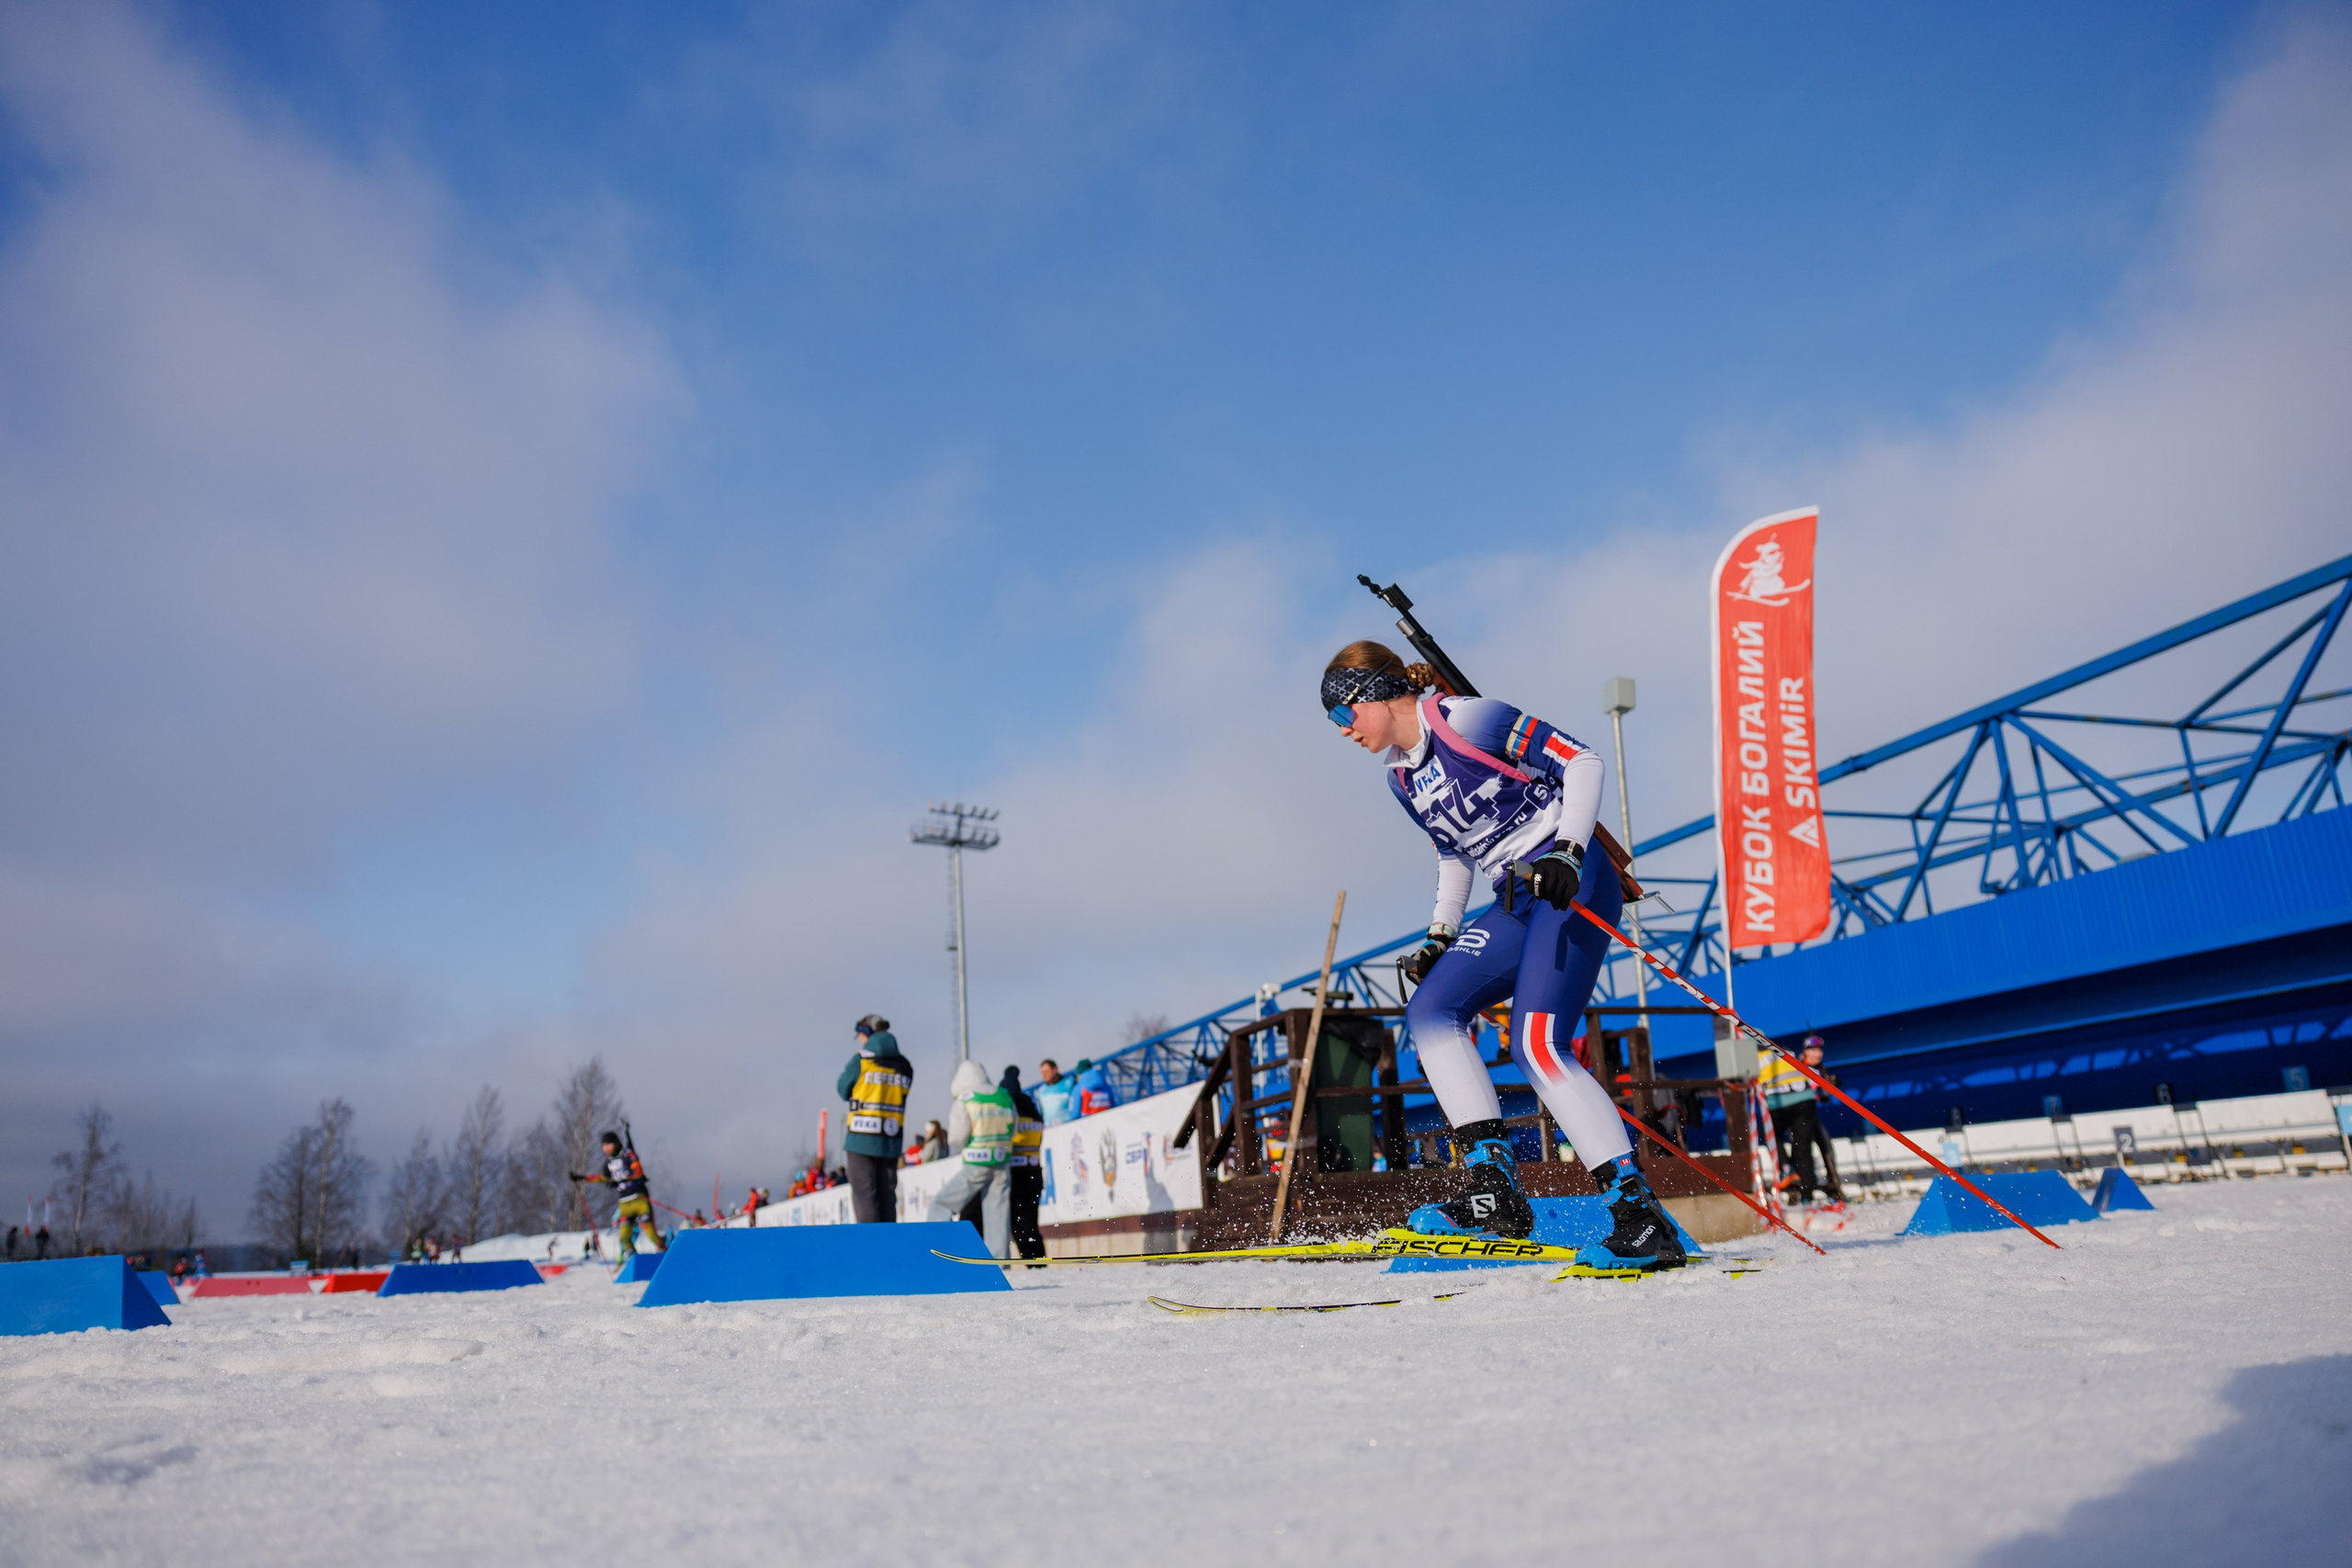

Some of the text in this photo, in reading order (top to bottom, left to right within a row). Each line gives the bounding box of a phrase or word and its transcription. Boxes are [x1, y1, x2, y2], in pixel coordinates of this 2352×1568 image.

[1732, 621, 1775, 932] КУБОК БОГАЛИЙ
[2289, 1067, 2304, 1091] 5
[2118, 1133, 2133, 1153] 2
[1632, 1224, 1657, 1247] salomon
[1371, 1238, 1544, 1257] FISCHER
